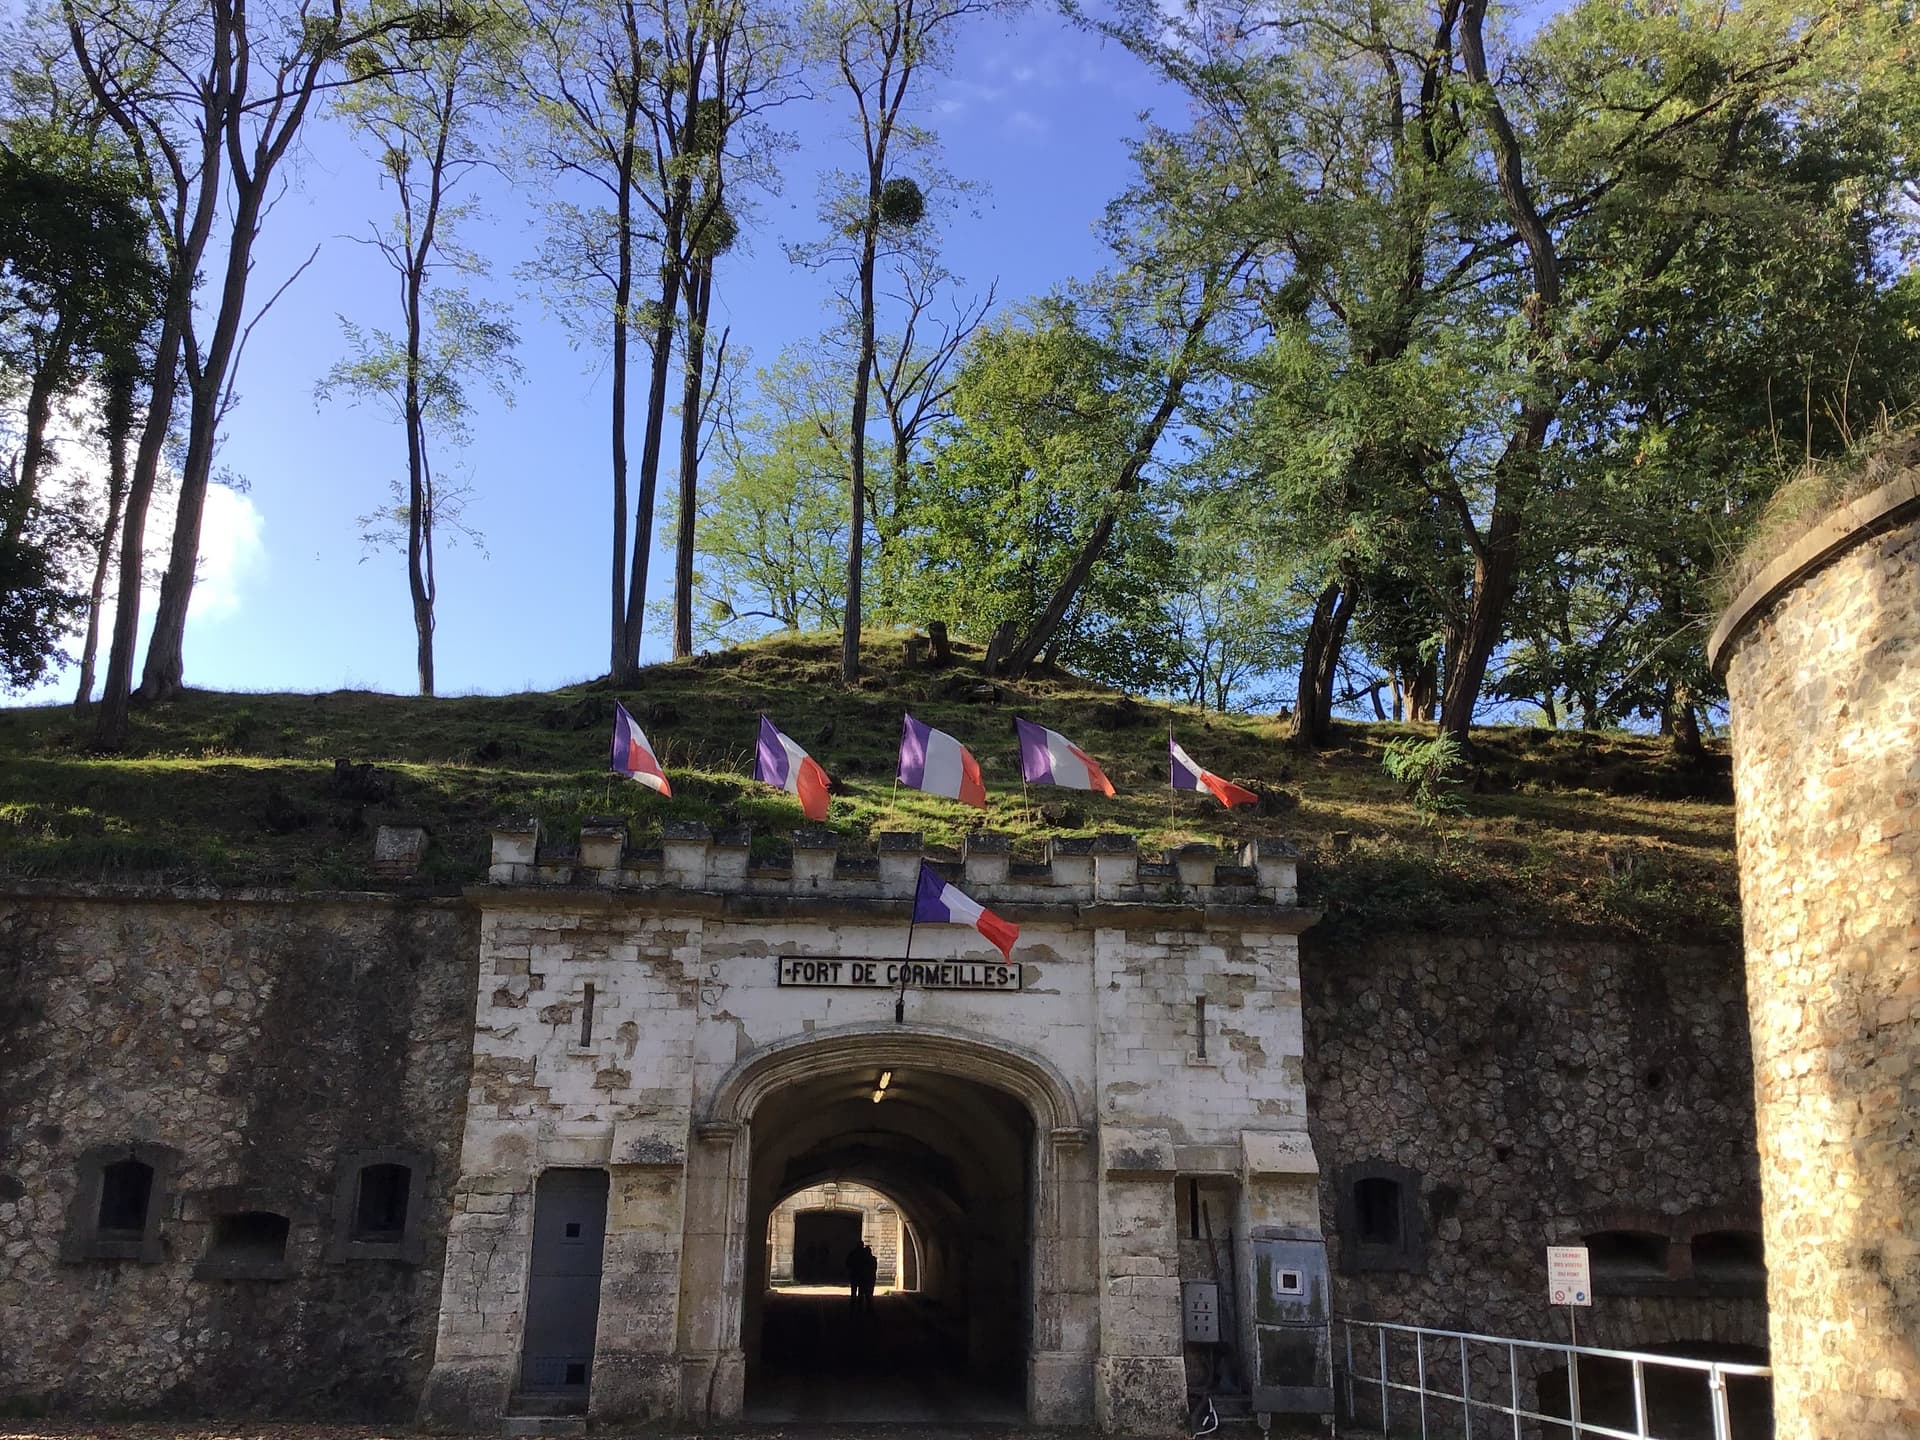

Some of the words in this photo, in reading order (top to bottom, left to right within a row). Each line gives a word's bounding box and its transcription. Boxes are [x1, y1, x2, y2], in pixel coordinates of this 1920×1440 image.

[792, 962, 843, 983] FORT
[852, 963, 877, 983] DE
[887, 963, 1009, 986] CORMEILLES
